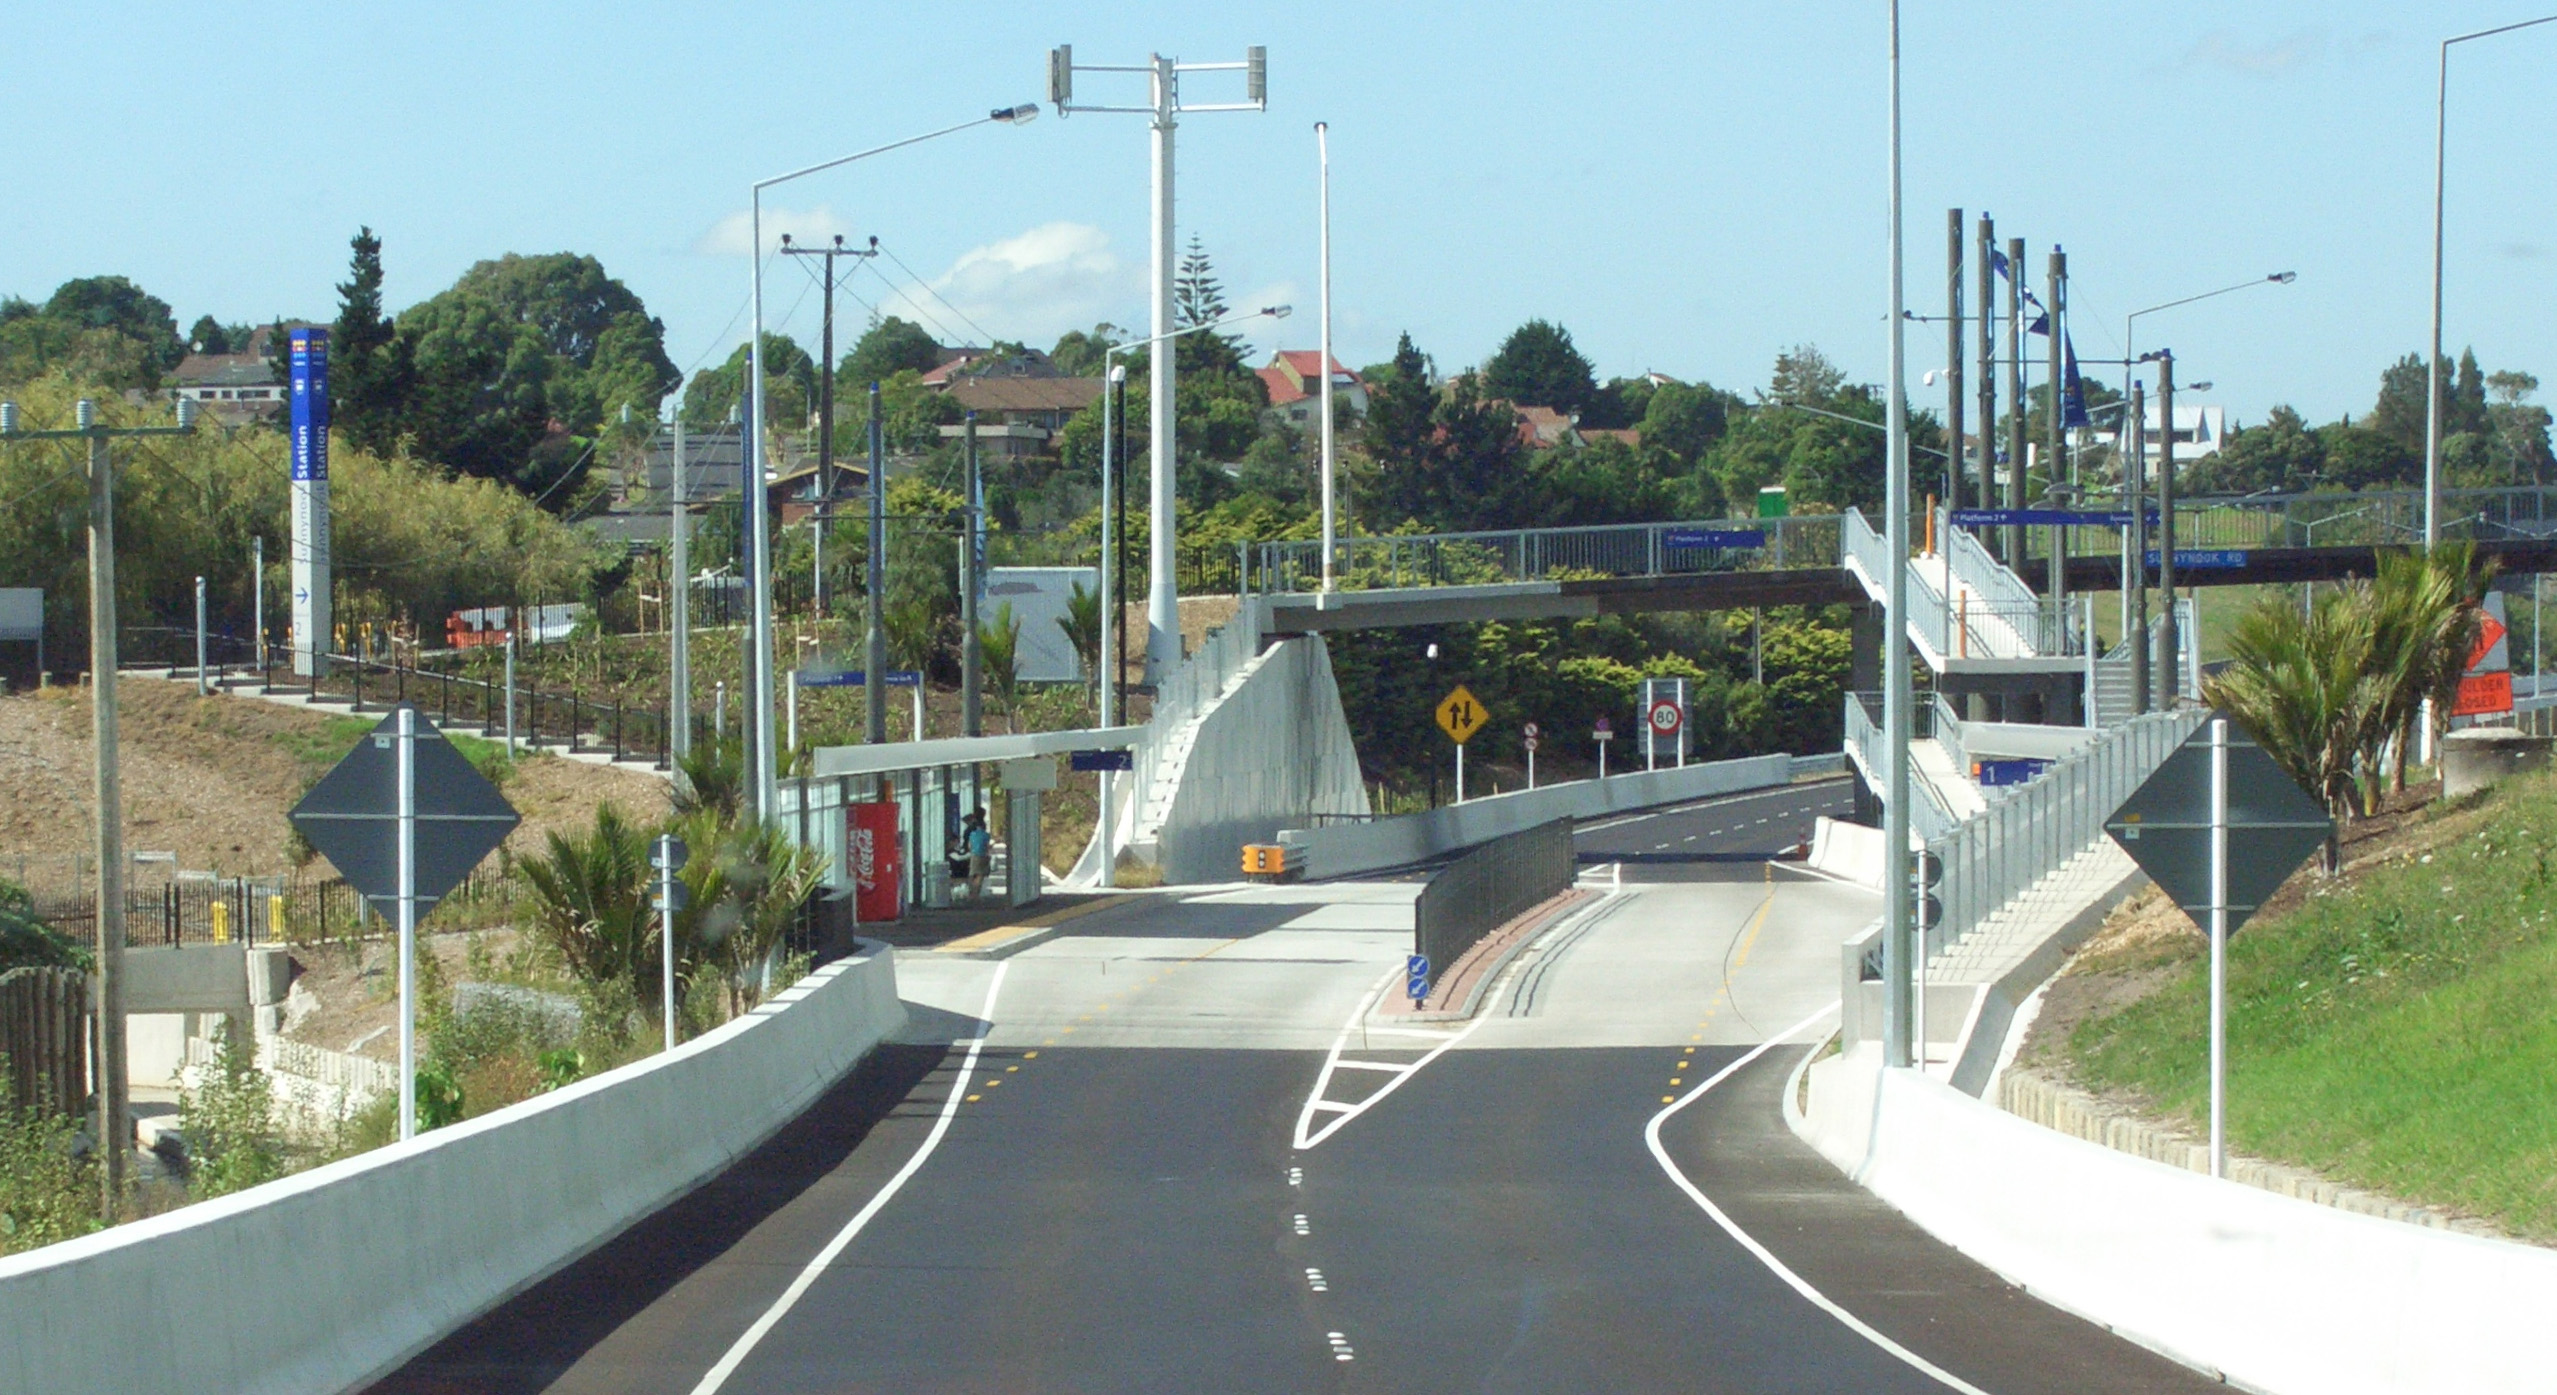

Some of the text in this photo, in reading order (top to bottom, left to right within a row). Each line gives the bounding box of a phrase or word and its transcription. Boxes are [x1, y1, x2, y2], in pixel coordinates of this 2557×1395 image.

[297, 425, 308, 479] Station
[316, 425, 327, 479] Station
[1960, 513, 1993, 522] Platform
[2148, 552, 2243, 564] SUNYNOOK RD
[1656, 711, 1676, 724] 80
[1118, 754, 1128, 769] 2
[1986, 765, 1996, 783] 1
